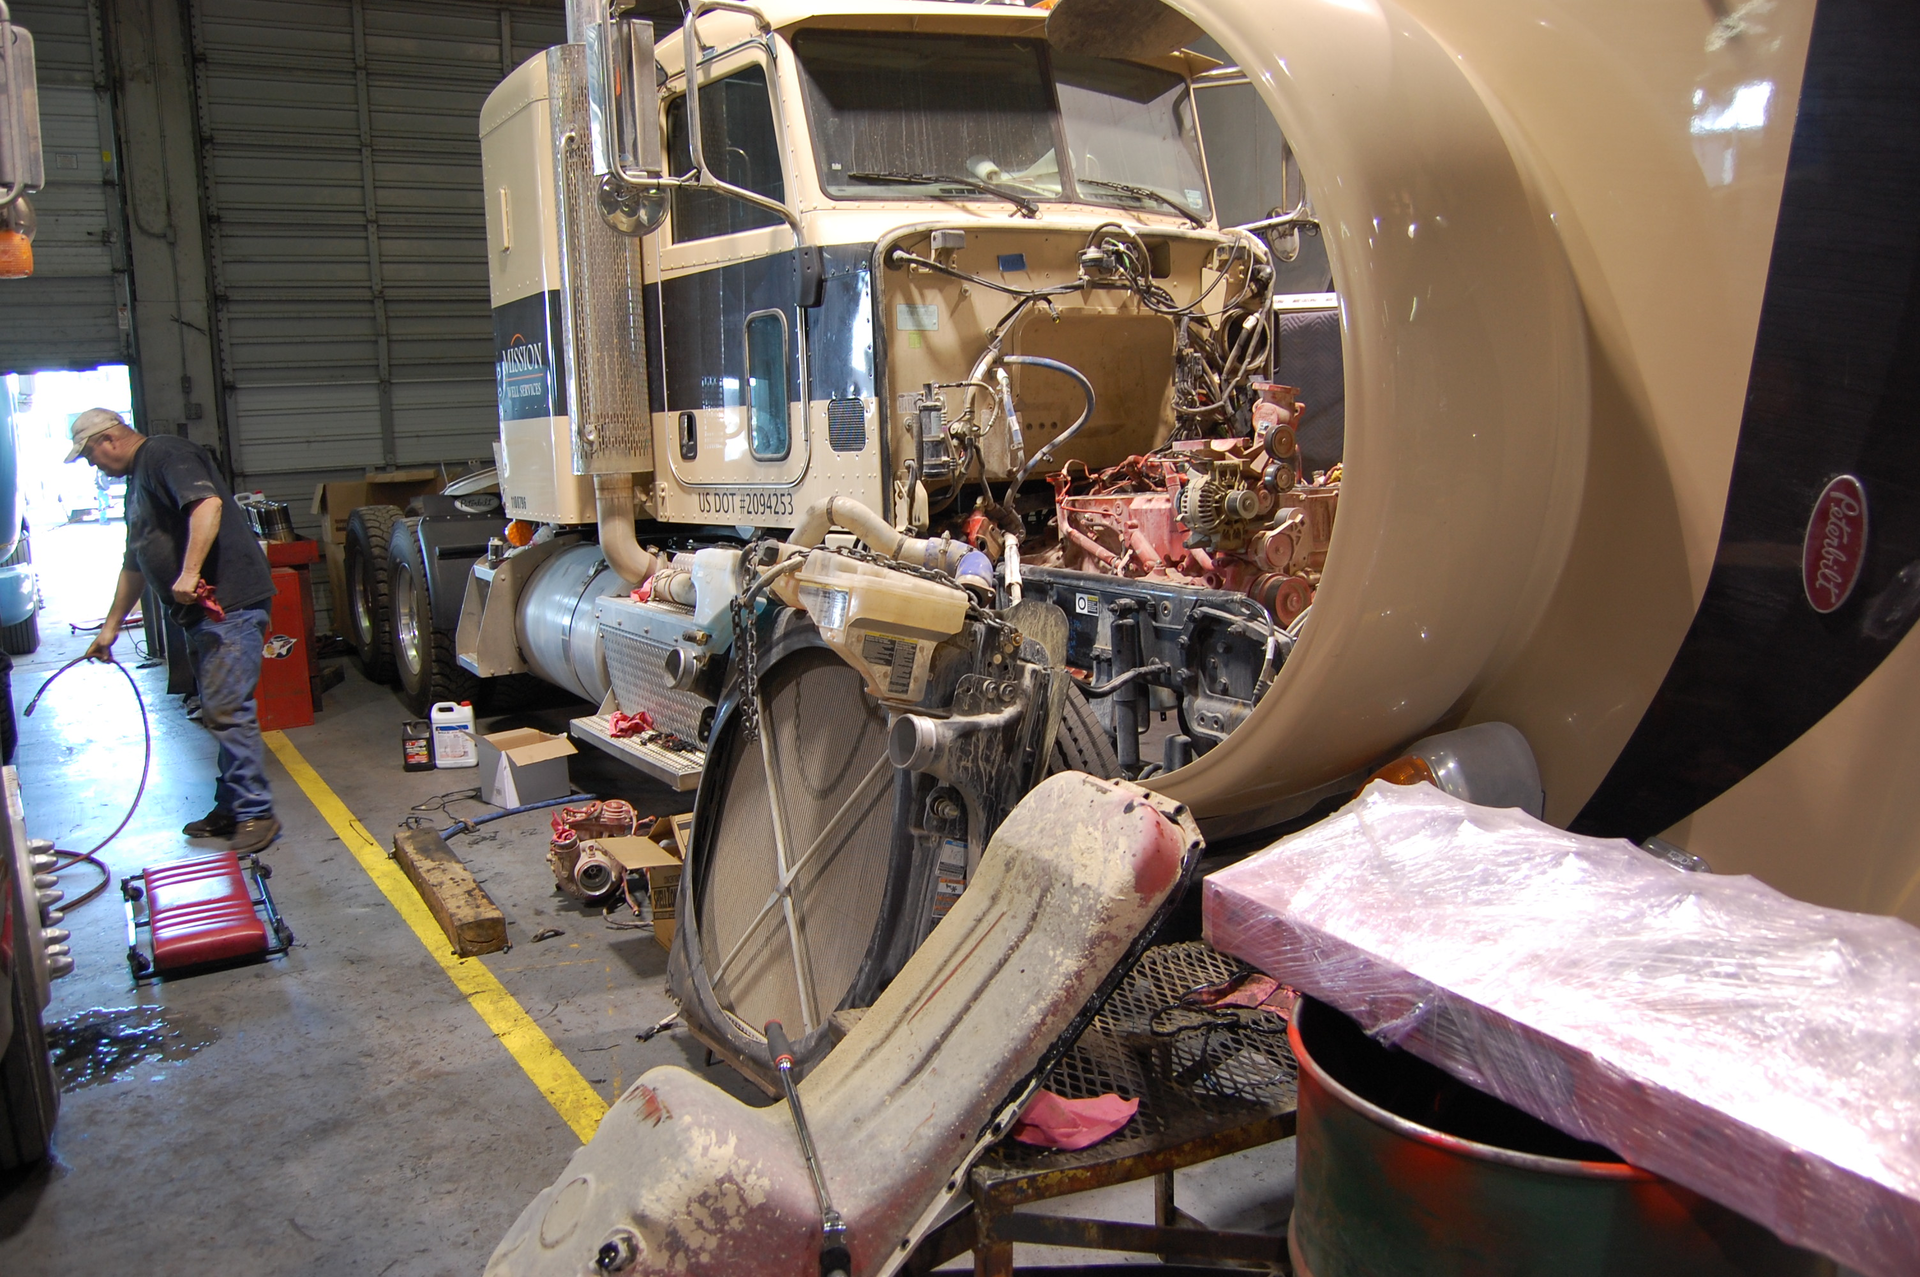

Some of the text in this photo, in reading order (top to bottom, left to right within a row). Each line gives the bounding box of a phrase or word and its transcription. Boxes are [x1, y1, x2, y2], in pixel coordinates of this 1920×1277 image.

[502, 342, 543, 374] MISSION
[507, 382, 542, 398] WELL SERVICES
[460, 497, 494, 509] Peterbilt
[698, 492, 794, 515] US DOT #2094253
[1815, 491, 1860, 604] Peterbilt
